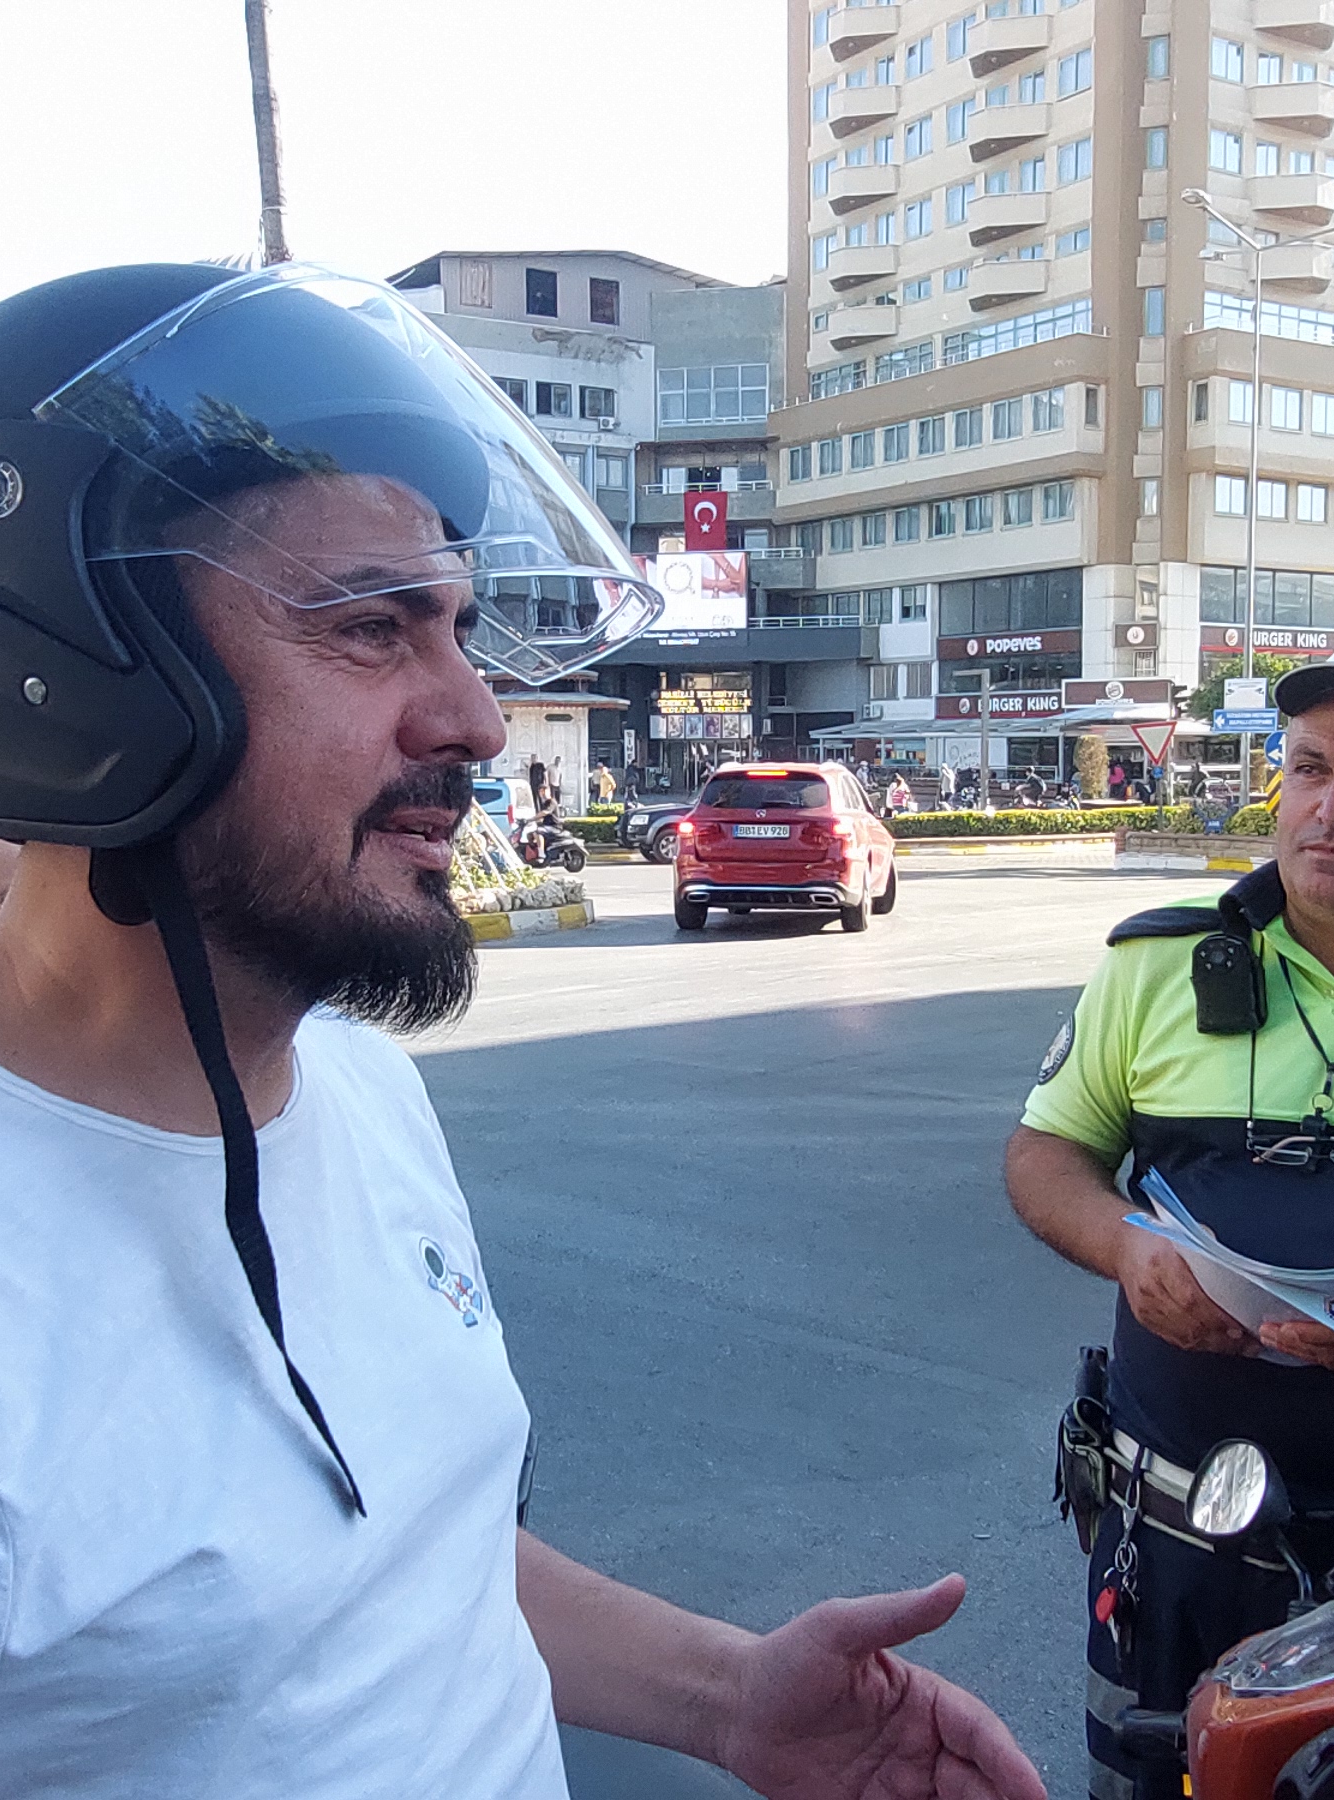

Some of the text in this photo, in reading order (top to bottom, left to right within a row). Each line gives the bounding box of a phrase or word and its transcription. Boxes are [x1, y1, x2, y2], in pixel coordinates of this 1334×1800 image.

[1252, 631, 1328, 649] URGER KING
[1027, 696, 1059, 712] KING
